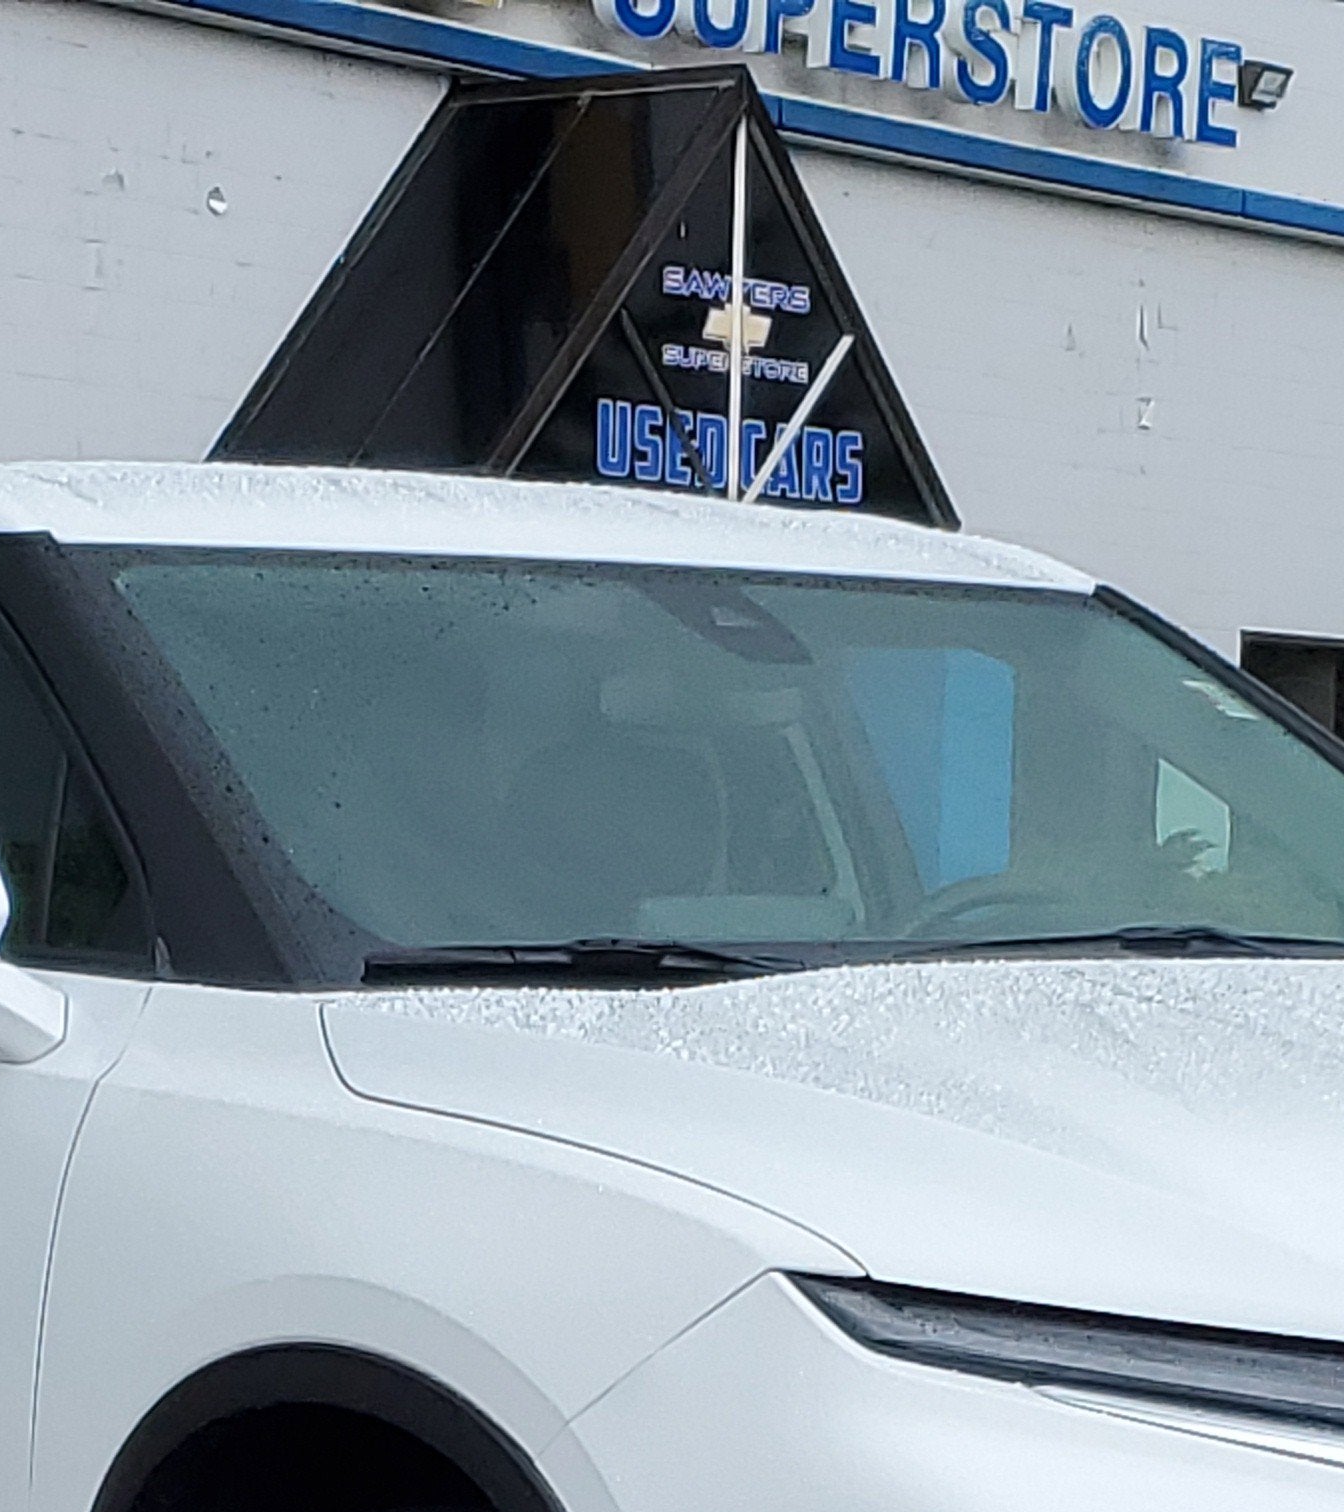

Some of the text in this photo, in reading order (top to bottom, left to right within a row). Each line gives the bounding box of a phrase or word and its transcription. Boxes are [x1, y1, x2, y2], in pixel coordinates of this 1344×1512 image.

[662, 343, 809, 384] SUPESTORE
[597, 399, 863, 503] USED CARS
